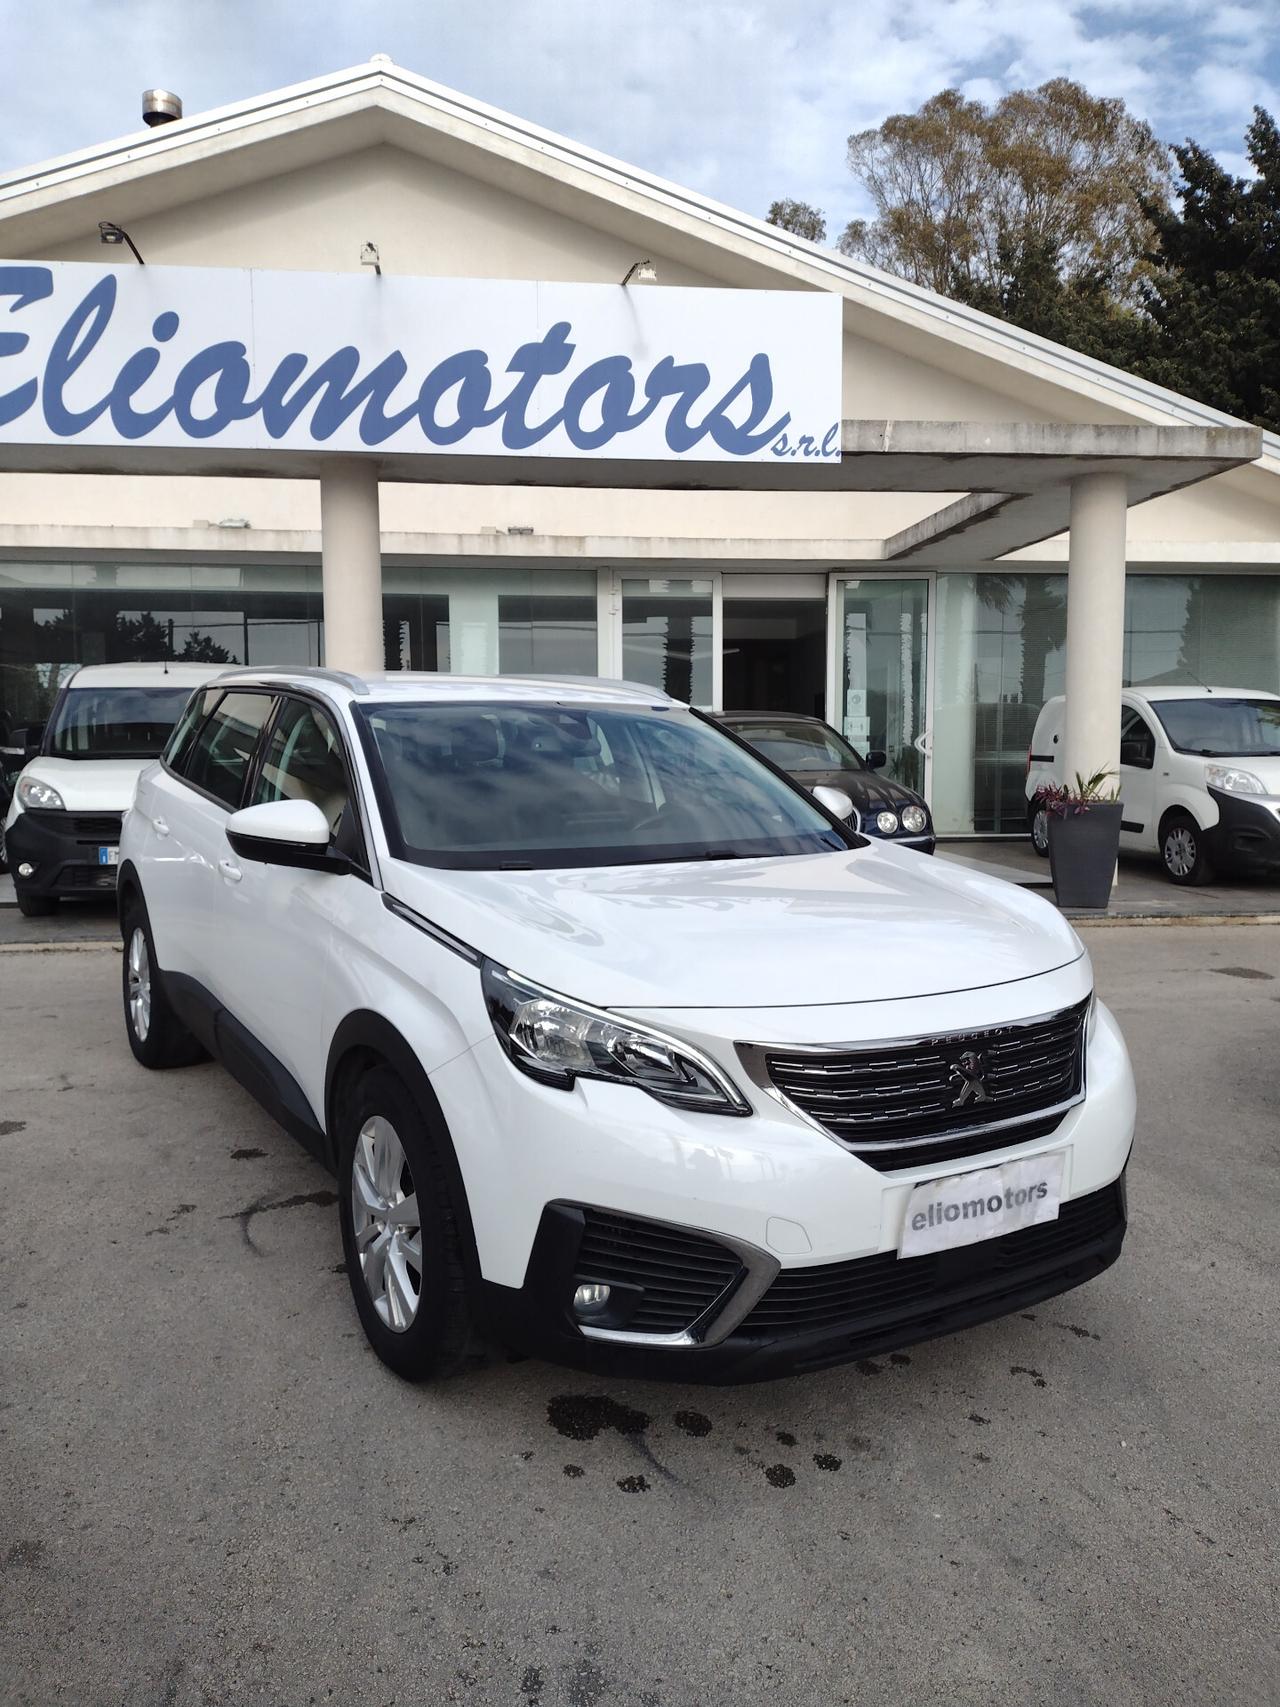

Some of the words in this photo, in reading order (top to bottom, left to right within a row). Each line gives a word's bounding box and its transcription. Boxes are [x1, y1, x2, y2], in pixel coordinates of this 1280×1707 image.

[770, 422, 841, 457] s.r.l.
[931, 1026, 1013, 1046] PEUGEOT
[911, 1181, 1049, 1231] eliomotors
